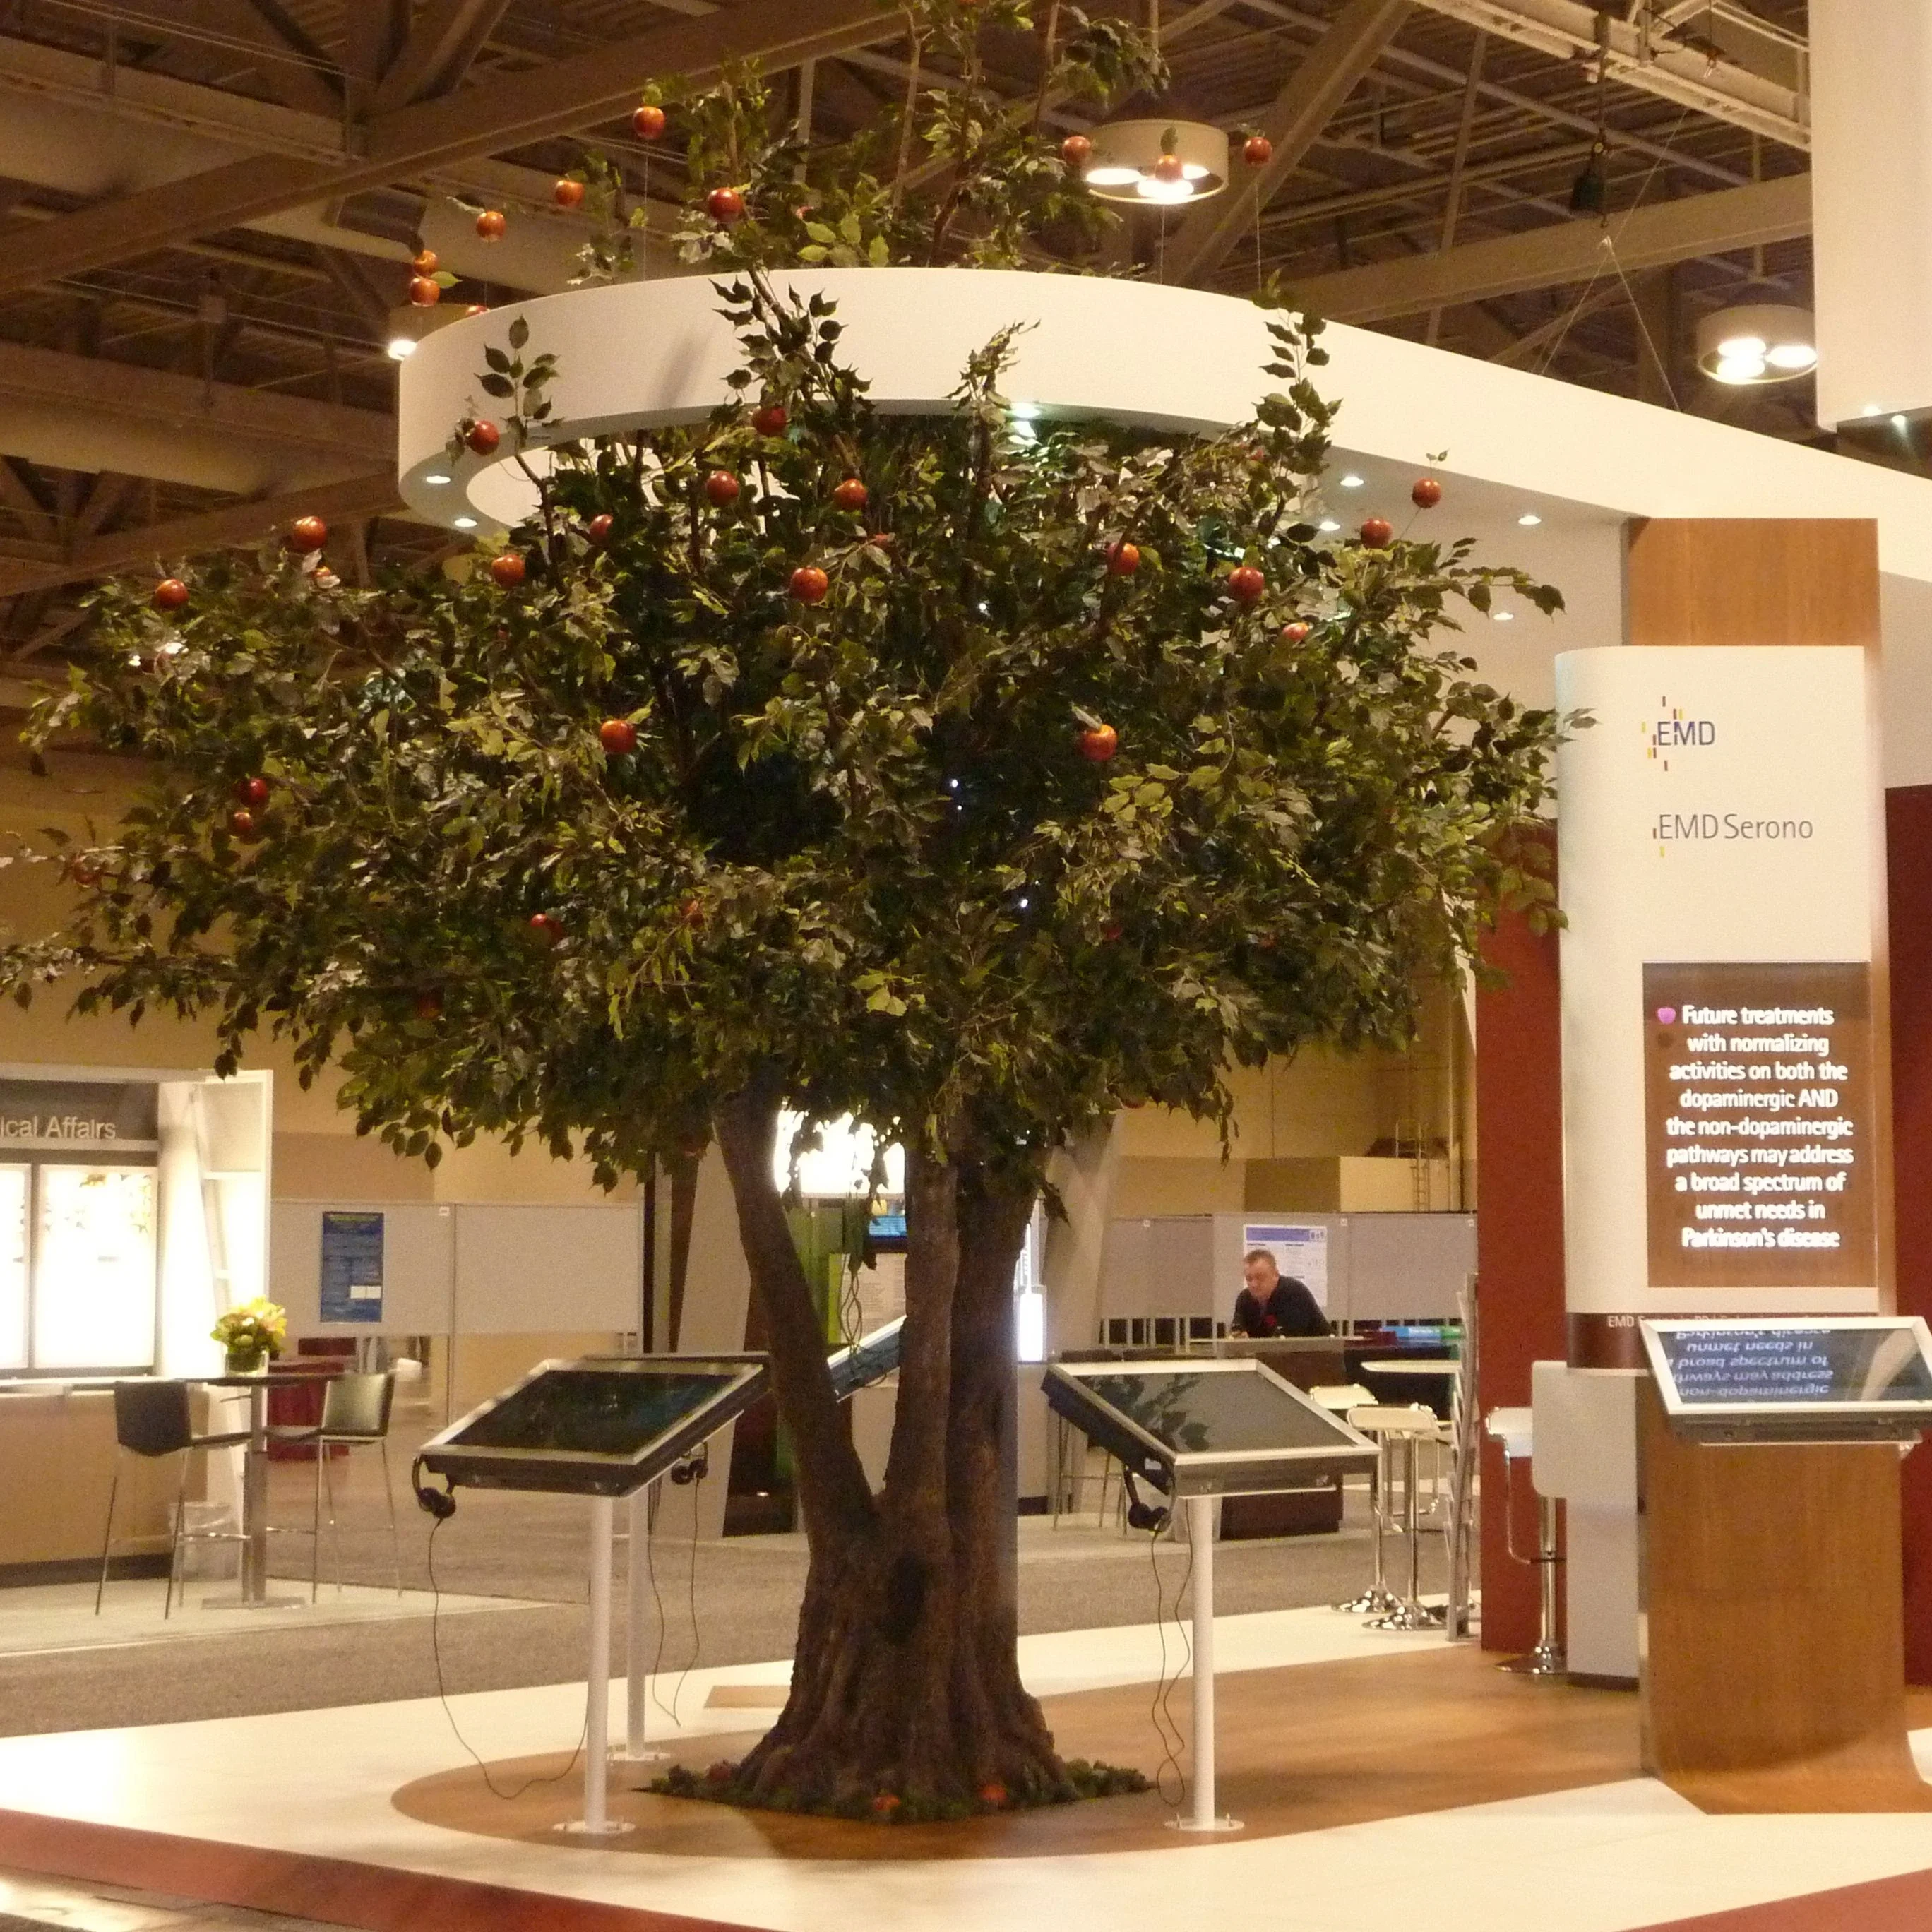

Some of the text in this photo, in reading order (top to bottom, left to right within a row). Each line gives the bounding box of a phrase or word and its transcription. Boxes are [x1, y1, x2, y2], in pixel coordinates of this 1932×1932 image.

[1657, 721, 1715, 746] EMD
[1659, 814, 1813, 839] EMD Serono
[1682, 1005, 1835, 1025] Future treatments
[1687, 1034, 1829, 1056] with normalizing
[1669, 1061, 1848, 1080] activities on both the
[1679, 1089, 1838, 1112] dopaminergic AND
[45, 1116, 117, 1139] Affairs
[1666, 1117, 1854, 1140] the non-dopaminergic
[1666, 1145, 1854, 1167] pathways may address
[1675, 1172, 1847, 1195] a broad spectrum of
[1695, 1200, 1825, 1220] unmet needs in
[1681, 1228, 1840, 1248] Parkinson's disease
[1607, 1316, 1635, 1328] EMD
